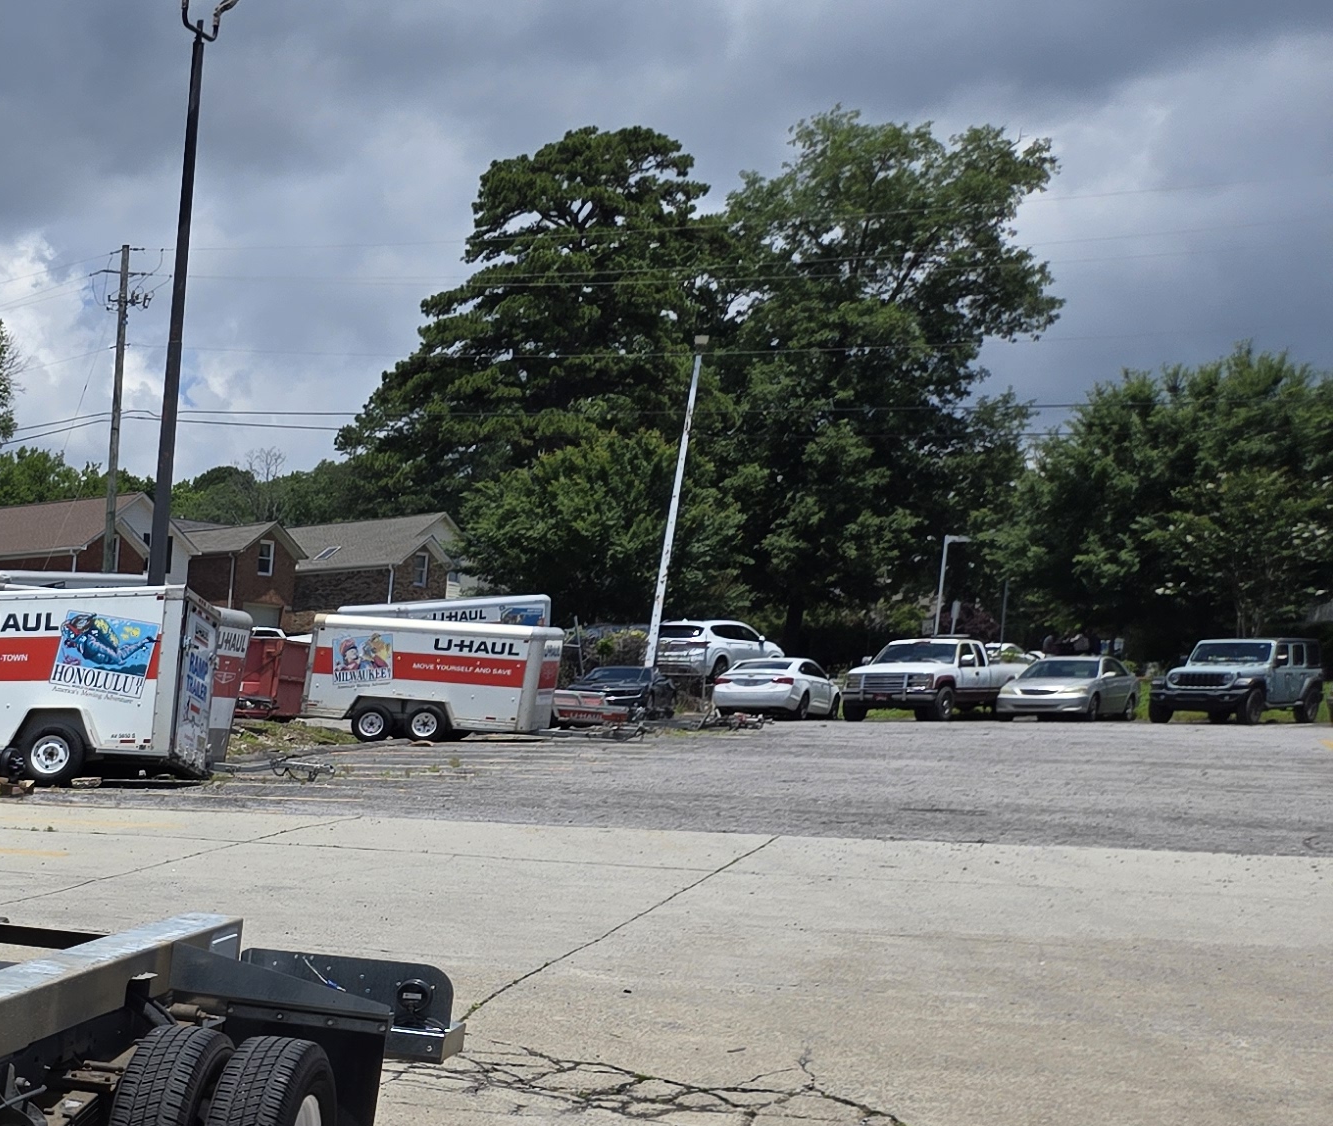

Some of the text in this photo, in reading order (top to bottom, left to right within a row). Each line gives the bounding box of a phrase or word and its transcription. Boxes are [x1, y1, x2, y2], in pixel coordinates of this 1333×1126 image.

[433, 609, 487, 622] U-HAUL
[217, 630, 247, 653] U-HAUL
[434, 638, 520, 656] U-HAUL
[189, 652, 209, 682] RAMP
[334, 668, 387, 682] MILWAUKEE
[412, 662, 435, 670] MOVE
[436, 664, 474, 673] YOURSELF
[492, 668, 513, 676] SAVE
[52, 664, 135, 694] HONOLULU
[186, 674, 208, 703] TRAILER
